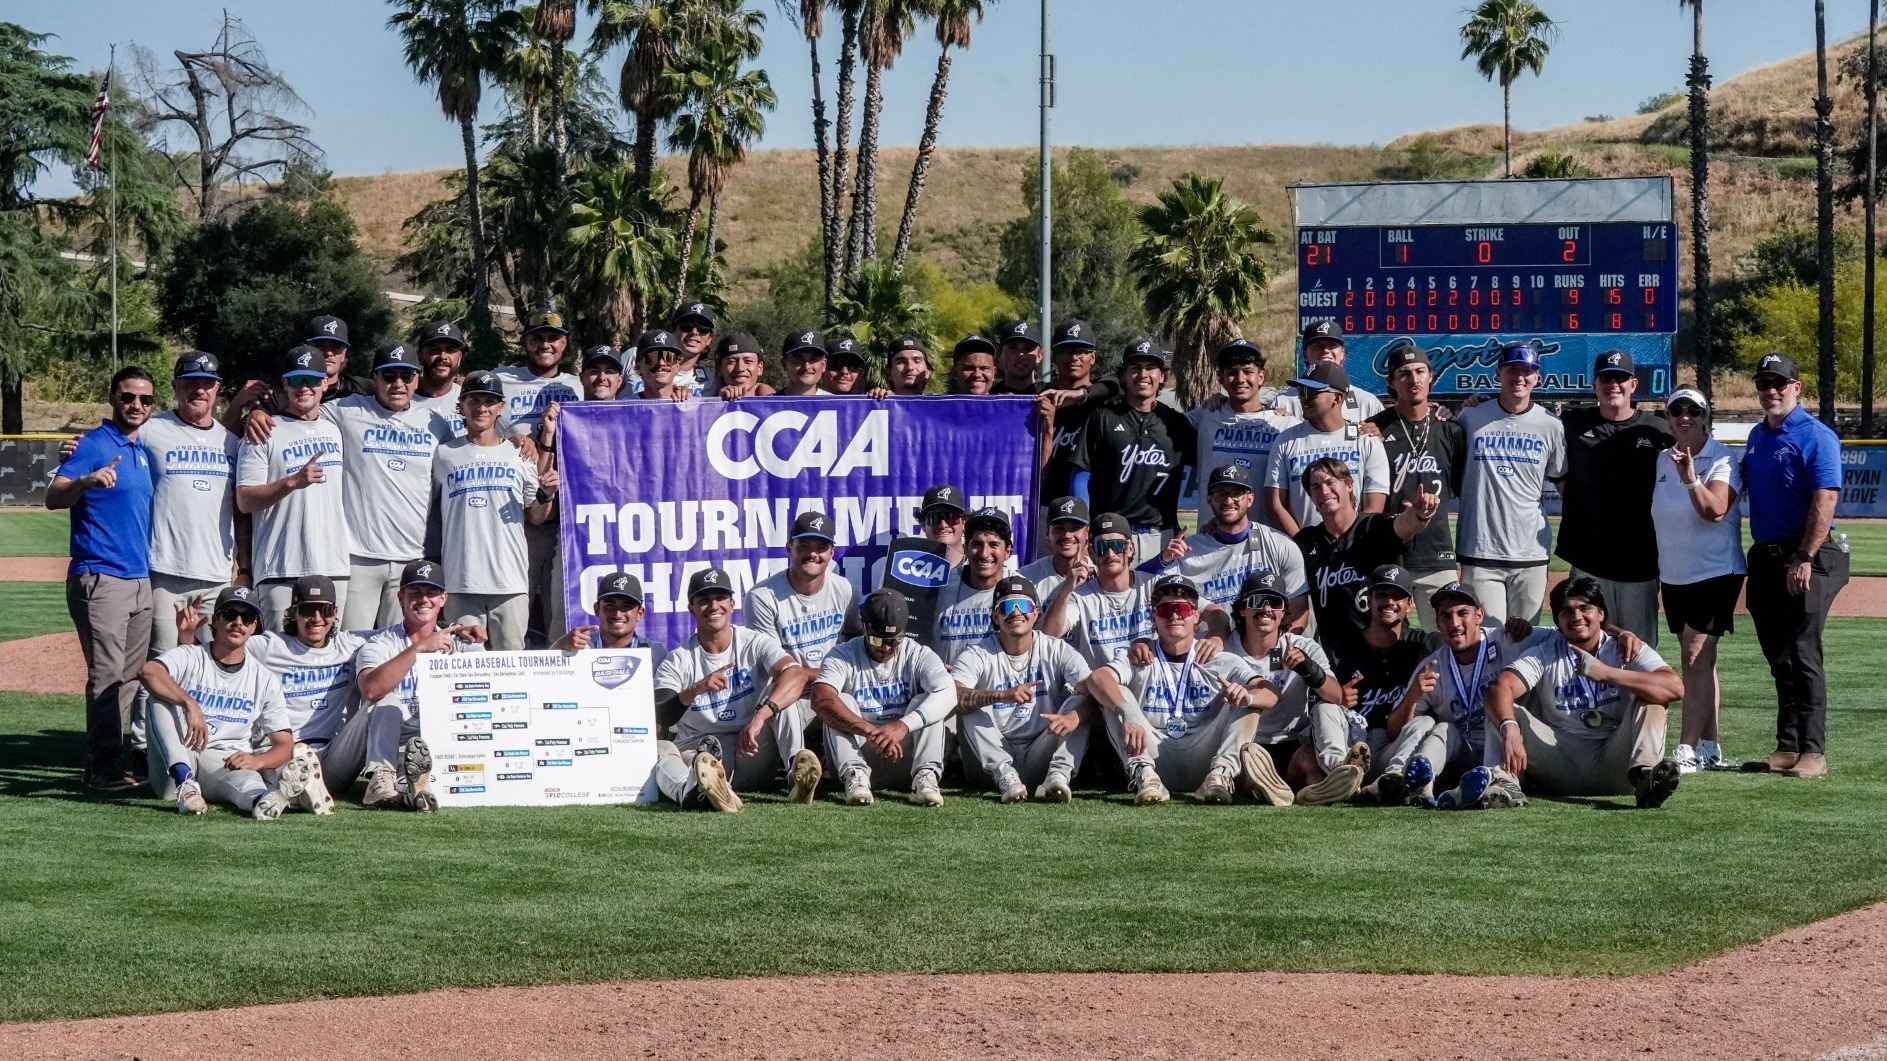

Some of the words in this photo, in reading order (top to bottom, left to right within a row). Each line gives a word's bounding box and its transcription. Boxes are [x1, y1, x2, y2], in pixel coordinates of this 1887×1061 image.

[1301, 231, 1313, 244] AT
[1317, 231, 1337, 243] BAT
[1388, 230, 1414, 243] BALL
[1465, 228, 1504, 241] STRIKE
[1559, 227, 1580, 240] OUT
[1643, 226, 1667, 239] H/E
[1307, 244, 1331, 265] 21
[1402, 244, 1408, 263] 1
[1479, 242, 1491, 262] 0
[1563, 241, 1576, 262] 2
[1346, 278, 1352, 290] 1
[1366, 277, 1374, 290] 2
[1386, 276, 1394, 290] 3
[1407, 276, 1416, 289] 4
[1428, 276, 1436, 289] 5
[1449, 276, 1456, 288] 6
[1470, 276, 1478, 288] 7
[1492, 276, 1499, 288] 8
[1512, 276, 1520, 288] 9
[1530, 275, 1544, 288] 10
[1554, 275, 1585, 288] RUNS
[1600, 274, 1625, 288] HITS
[1638, 274, 1660, 287] ERR
[1300, 292, 1338, 307] GUEST
[1346, 292, 1354, 307] 2
[1366, 291, 1374, 306] 0
[1386, 291, 1395, 306] 0
[1408, 291, 1416, 306] 0
[1428, 290, 1436, 306] 2
[1449, 290, 1458, 306] 2
[1470, 290, 1478, 306] 0
[1492, 290, 1500, 306] 0
[1512, 290, 1521, 305] 3
[1569, 289, 1578, 304] 9
[1610, 288, 1620, 304] 15
[1645, 288, 1654, 304] 0
[1346, 316, 1354, 331] 6
[1366, 316, 1374, 330] 0
[1386, 316, 1395, 330] 0
[1408, 315, 1416, 330] 0
[1428, 315, 1436, 330] 0
[1449, 315, 1458, 330] 0
[1470, 315, 1478, 330] 0
[1492, 314, 1500, 330] 0
[1569, 314, 1578, 329] 6
[1612, 314, 1621, 328] 8
[1650, 314, 1654, 328] 1
[1456, 374, 1592, 390] BASALL
[1652, 368, 1665, 394] 0
[364, 429, 432, 450] CHAMPS
[706, 409, 889, 480] CCAA
[1474, 436, 1544, 458] CHAMPS
[282, 442, 340, 468] CHAMPS
[1298, 446, 1352, 456] UNDISPUTED
[1841, 450, 1868, 465] 990
[166, 450, 234, 470] CHAMPS
[389, 460, 406, 469] CCAA
[454, 462, 508, 472] UNDISPUTED
[1121, 444, 1170, 483] Yotes
[1234, 459, 1251, 468] CCAA
[447, 466, 516, 490] CHAMPS
[1394, 452, 1442, 493] Yotes
[1498, 466, 1514, 476] CCAA
[1843, 470, 1882, 486] RYAN
[1153, 472, 1170, 496] 7
[470, 497, 486, 506] CCAA
[1843, 488, 1878, 504] LOVE
[897, 556, 946, 582] CCAA
[1316, 562, 1366, 607] Yotes
[782, 614, 843, 644] CHAMPS
[940, 614, 991, 635] CHAM
[1089, 609, 1153, 640] CHAMPS
[430, 660, 448, 670] 2026
[452, 658, 472, 670] CCAA
[476, 657, 516, 669] BASEBALL
[518, 656, 570, 668] TOURNAMENT
[806, 651, 823, 659] CCAA
[594, 668, 631, 678] BASEBALL
[719, 710, 736, 719] CCAA
[1168, 724, 1186, 732] CCAA
